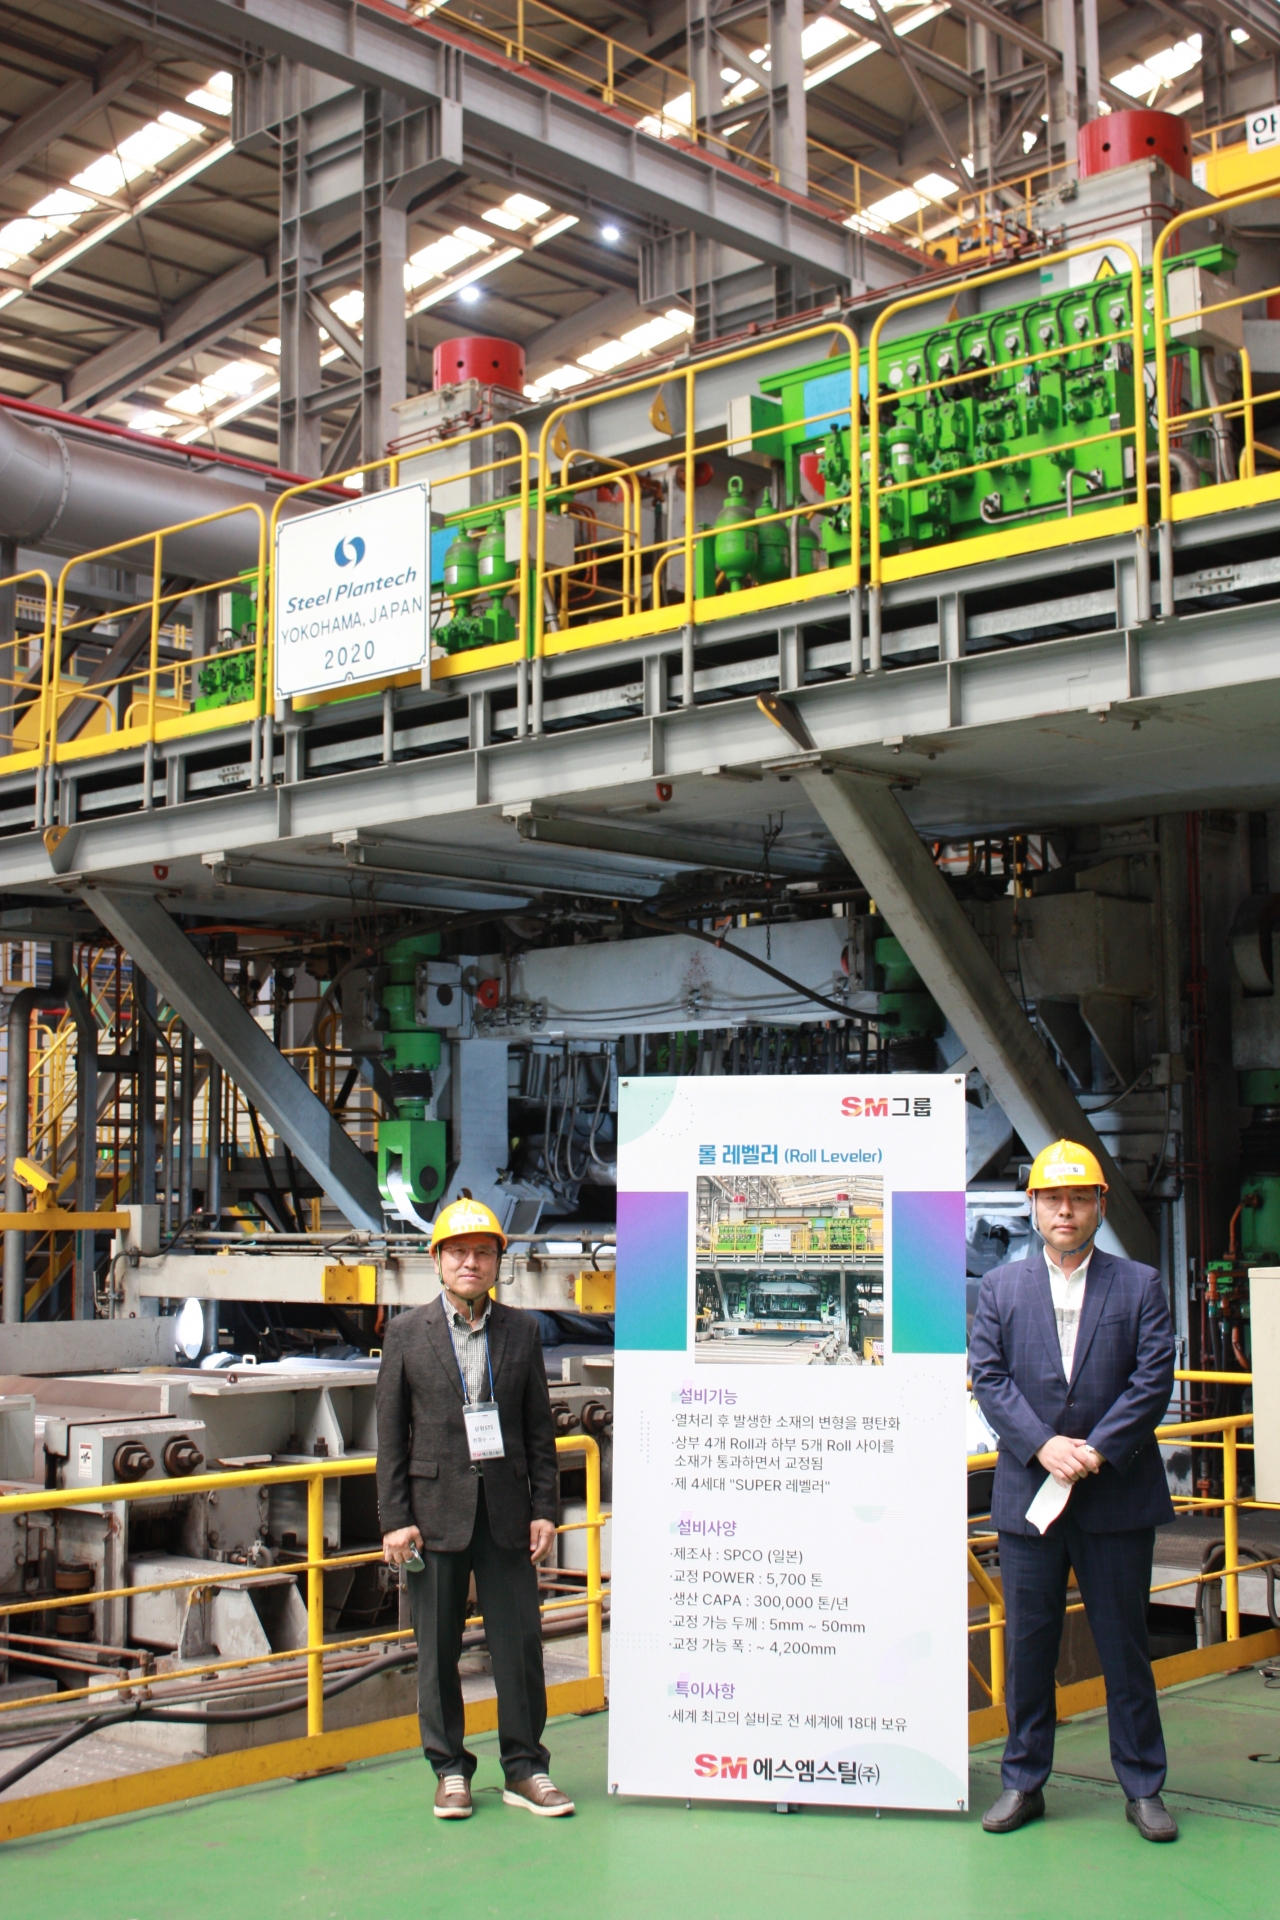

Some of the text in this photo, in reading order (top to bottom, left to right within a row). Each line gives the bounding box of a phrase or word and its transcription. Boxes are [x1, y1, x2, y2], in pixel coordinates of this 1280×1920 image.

[1252, 113, 1278, 145] 안
[285, 566, 417, 614] Steel Plantech
[281, 596, 422, 645] YOKOHAMA, JAPAN
[324, 640, 375, 670] 2020
[697, 1144, 883, 1166] 롤 레벨러 (Roll Leveler)
[678, 1388, 738, 1406] 설비기능
[716, 1414, 730, 1429] 후
[733, 1414, 773, 1429] 발생한
[775, 1415, 814, 1430] 소재의
[818, 1416, 858, 1431] 변형을
[861, 1416, 901, 1431] 평탄화
[703, 1437, 726, 1451] 4개
[730, 1437, 768, 1452] Roll과
[771, 1438, 797, 1452] 하부
[801, 1438, 823, 1453] 5개
[826, 1440, 852, 1452] Roll
[855, 1439, 895, 1454] 사이를
[674, 1454, 823, 1471] 소재가 통과하면서 교정됨
[690, 1477, 726, 1492] 4세대
[676, 1519, 738, 1538] 설비사양
[723, 1549, 764, 1562] SPCO
[767, 1549, 803, 1565] (일본)
[702, 1571, 755, 1585] POWER
[766, 1573, 807, 1588] 5,700
[810, 1573, 824, 1588] 톤
[702, 1594, 742, 1607] CAPA
[753, 1595, 814, 1612] 300,000
[817, 1596, 849, 1612] 톤/년
[702, 1615, 728, 1631] 가능
[731, 1617, 758, 1632] 두께
[769, 1619, 804, 1632] 5mm
[821, 1620, 866, 1634] 50mm
[702, 1638, 728, 1653] 가능
[731, 1639, 744, 1654] 폭
[769, 1642, 837, 1657] 4,200mm
[674, 1681, 736, 1701] 특이사항
[701, 1710, 740, 1726] 최고의
[744, 1712, 783, 1728] 설비로
[787, 1714, 800, 1728] 전
[803, 1714, 843, 1730] 세계에
[847, 1717, 877, 1732] 18대
[880, 1718, 908, 1733] 보유
[693, 1754, 748, 1780] SM
